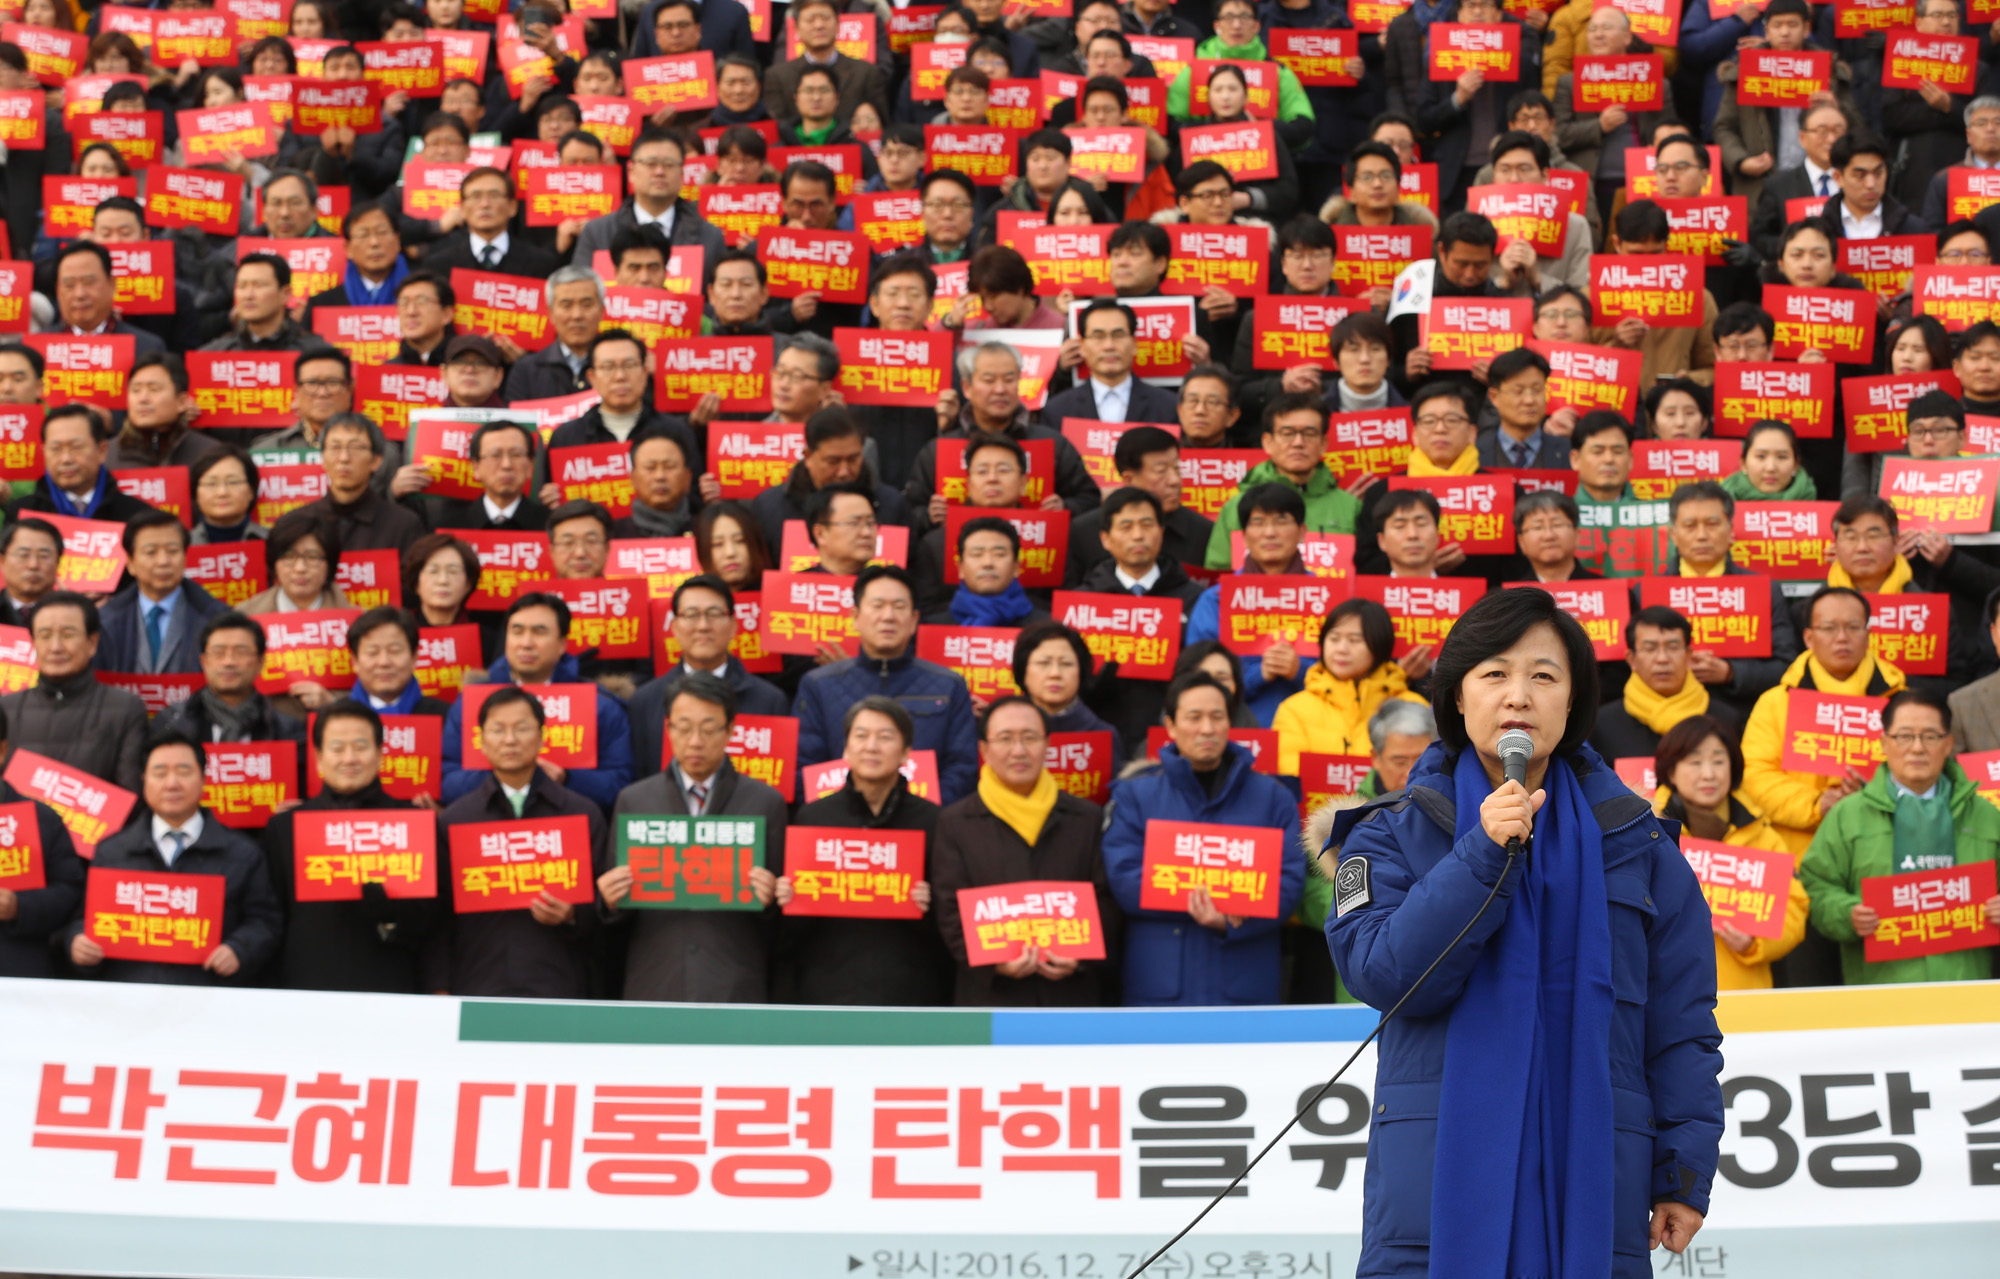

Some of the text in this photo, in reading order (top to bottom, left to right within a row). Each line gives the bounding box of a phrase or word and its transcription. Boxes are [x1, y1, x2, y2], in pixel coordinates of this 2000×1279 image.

[158, 17, 225, 37] 새누리당
[1842, 7, 1914, 28] 즉각탄핵!
[157, 37, 231, 58] 탄핵동참!
[1288, 37, 1340, 56] 박근혜
[1449, 30, 1502, 50] 박근혜
[1894, 40, 1964, 63] 새누리당
[365, 48, 432, 68] 새누리당
[1436, 50, 1511, 71] 즉각탄핵!
[1759, 58, 1812, 77] 박근혜
[1893, 58, 1968, 83] 탄핵동참!
[643, 61, 697, 83] 박근혜
[1582, 62, 1650, 81] 새누리당
[300, 88, 367, 105] 새누리당
[633, 79, 708, 105] 즉각탄핵!
[1582, 82, 1656, 102] 탄핵동참!
[91, 118, 145, 139] 박근혜
[198, 109, 254, 133] 박근혜
[299, 107, 374, 128] 탄핵동참!
[189, 127, 265, 154] 즉각탄핵!
[933, 134, 1004, 154] 새누리당
[1191, 129, 1260, 153] 새누리당
[932, 154, 1010, 175] 탄핵동참!
[62, 184, 118, 204] 박근혜
[167, 175, 224, 199] 박근혜
[546, 172, 603, 193] 박근혜
[150, 194, 232, 223] 즉각탄핵!
[533, 194, 613, 215] 즉각탄핵!
[707, 193, 778, 213] 새누리당
[1478, 194, 1557, 217] 새누리당
[1493, 217, 1561, 243] 핵동참!
[1666, 206, 1730, 230] 누리당
[767, 237, 853, 265] 새누리당
[1035, 234, 1100, 258] 박근혜
[1181, 233, 1247, 258] 박근혜
[1346, 235, 1411, 259] 박근혜
[1848, 246, 1914, 269] 박근혜
[110, 251, 151, 275] 근혜
[766, 261, 859, 290] 탄핵동참!
[1600, 264, 1687, 289] 새누리당
[474, 281, 539, 311] 박근혜
[1600, 291, 1694, 316] 탄핵동참!
[454, 304, 548, 338] 즉각탄핵!
[1444, 307, 1510, 331] 박근혜
[1787, 296, 1854, 322] 박근혜
[47, 343, 112, 369] 박근혜
[860, 339, 928, 364] 박근혜
[1428, 333, 1523, 357] 즉각탄핵!
[666, 347, 756, 372] 새누리당
[1550, 350, 1618, 381] 박근혜
[212, 361, 280, 387] 박근혜
[666, 374, 763, 399] 탄핵동참!
[841, 365, 941, 393] 즉각탄핵!
[1741, 371, 1810, 396] 박근혜
[195, 388, 292, 414] 즉각탄핵!
[1545, 377, 1627, 410] 각탄핵!
[1723, 398, 1822, 424] 즉각탄핵!
[1337, 419, 1407, 447] 박근혜
[1177, 459, 1246, 484] 박근혜
[1648, 450, 1719, 475] 박근혜
[119, 479, 166, 502] 근혜
[1893, 469, 1983, 494] 새누리당
[1438, 514, 1504, 541] 핵동참!
[1579, 506, 1613, 527] 근혜
[1745, 511, 1818, 537] 박근혜
[619, 548, 691, 573] 박근혜
[1231, 586, 1330, 614] 새누리당
[1385, 587, 1460, 615] 박근혜
[1670, 587, 1745, 614] 박근혜
[1063, 605, 1162, 636] 새누리당
[1081, 634, 1169, 665] 핵동참!
[30, 766, 107, 815] 박근혜
[200, 783, 285, 813] 각탄핵!
[326, 822, 408, 852] 박근혜
[627, 821, 755, 845] 박근혜 대통령
[481, 830, 562, 862] 박근혜
[816, 839, 897, 869] 박근혜
[1175, 834, 1254, 866] 박근혜
[305, 853, 422, 885] 즉각탄핵!
[463, 860, 578, 896] 즉각탄핵!
[628, 846, 752, 902] 탄핵!
[1685, 849, 1766, 888] 박근혜
[794, 870, 911, 903] 즉각탄핵!
[1152, 864, 1267, 901] 즉각탄핵!
[1893, 877, 1970, 911] 박근혜
[116, 882, 197, 914] 박근혜
[975, 892, 1076, 921] 새누리당
[94, 912, 210, 948] 즉각탄핵!
[977, 918, 1090, 950] 탄핵동참!
[1874, 904, 1986, 945] 즉각탄핵!
[32, 1063, 419, 1186] 박근혜
[450, 1082, 834, 1199] 대통령
[871, 1082, 1255, 1200] 탄핵을
[1201, 1250, 1334, 1279] 오후3시
